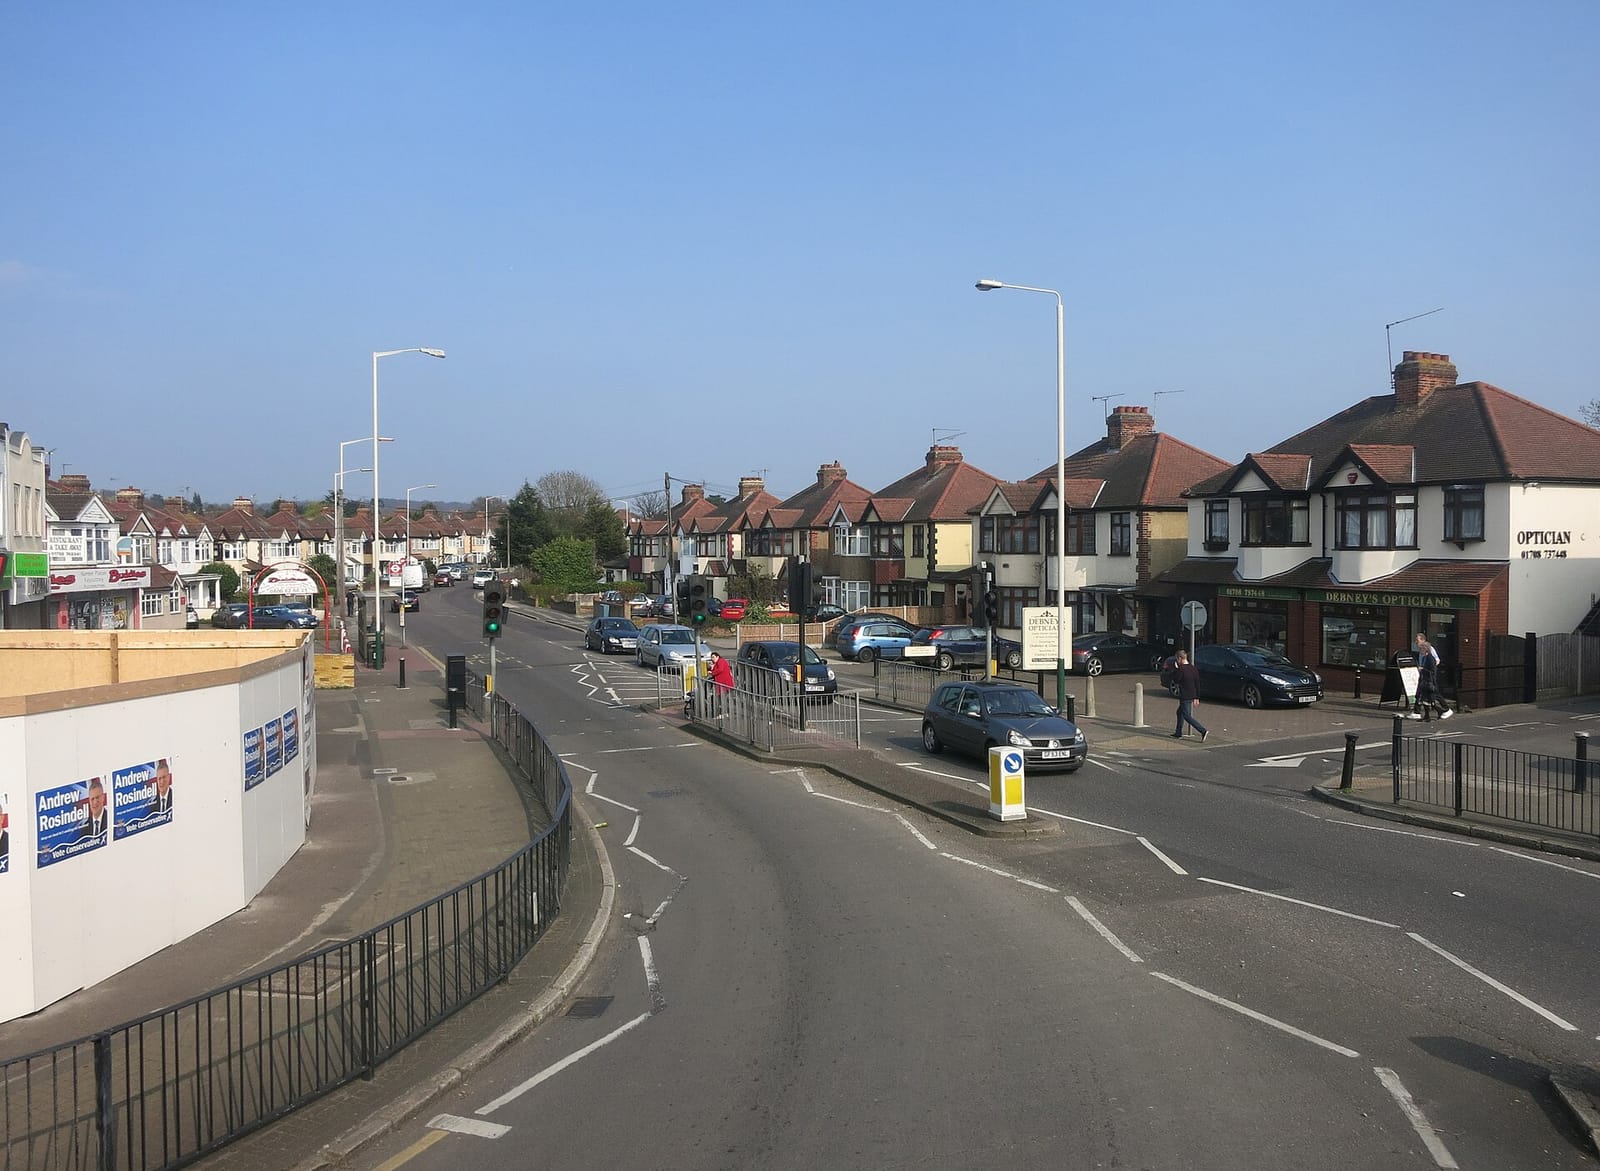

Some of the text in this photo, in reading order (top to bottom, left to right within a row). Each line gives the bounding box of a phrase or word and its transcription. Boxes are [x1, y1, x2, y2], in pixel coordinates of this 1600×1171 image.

[1517, 530, 1571, 545] OPTICIAN
[1521, 550, 1541, 559] 01708
[1326, 591, 1450, 608] DEBNEY'S OPTICIANS
[115, 770, 149, 789] Andrew
[39, 790, 80, 812] Andrew
[115, 782, 157, 808] Rosindell
[40, 803, 89, 831] Rosindell
[126, 814, 167, 832] Vote Conservative
[52, 839, 100, 859] Vote Conservative
